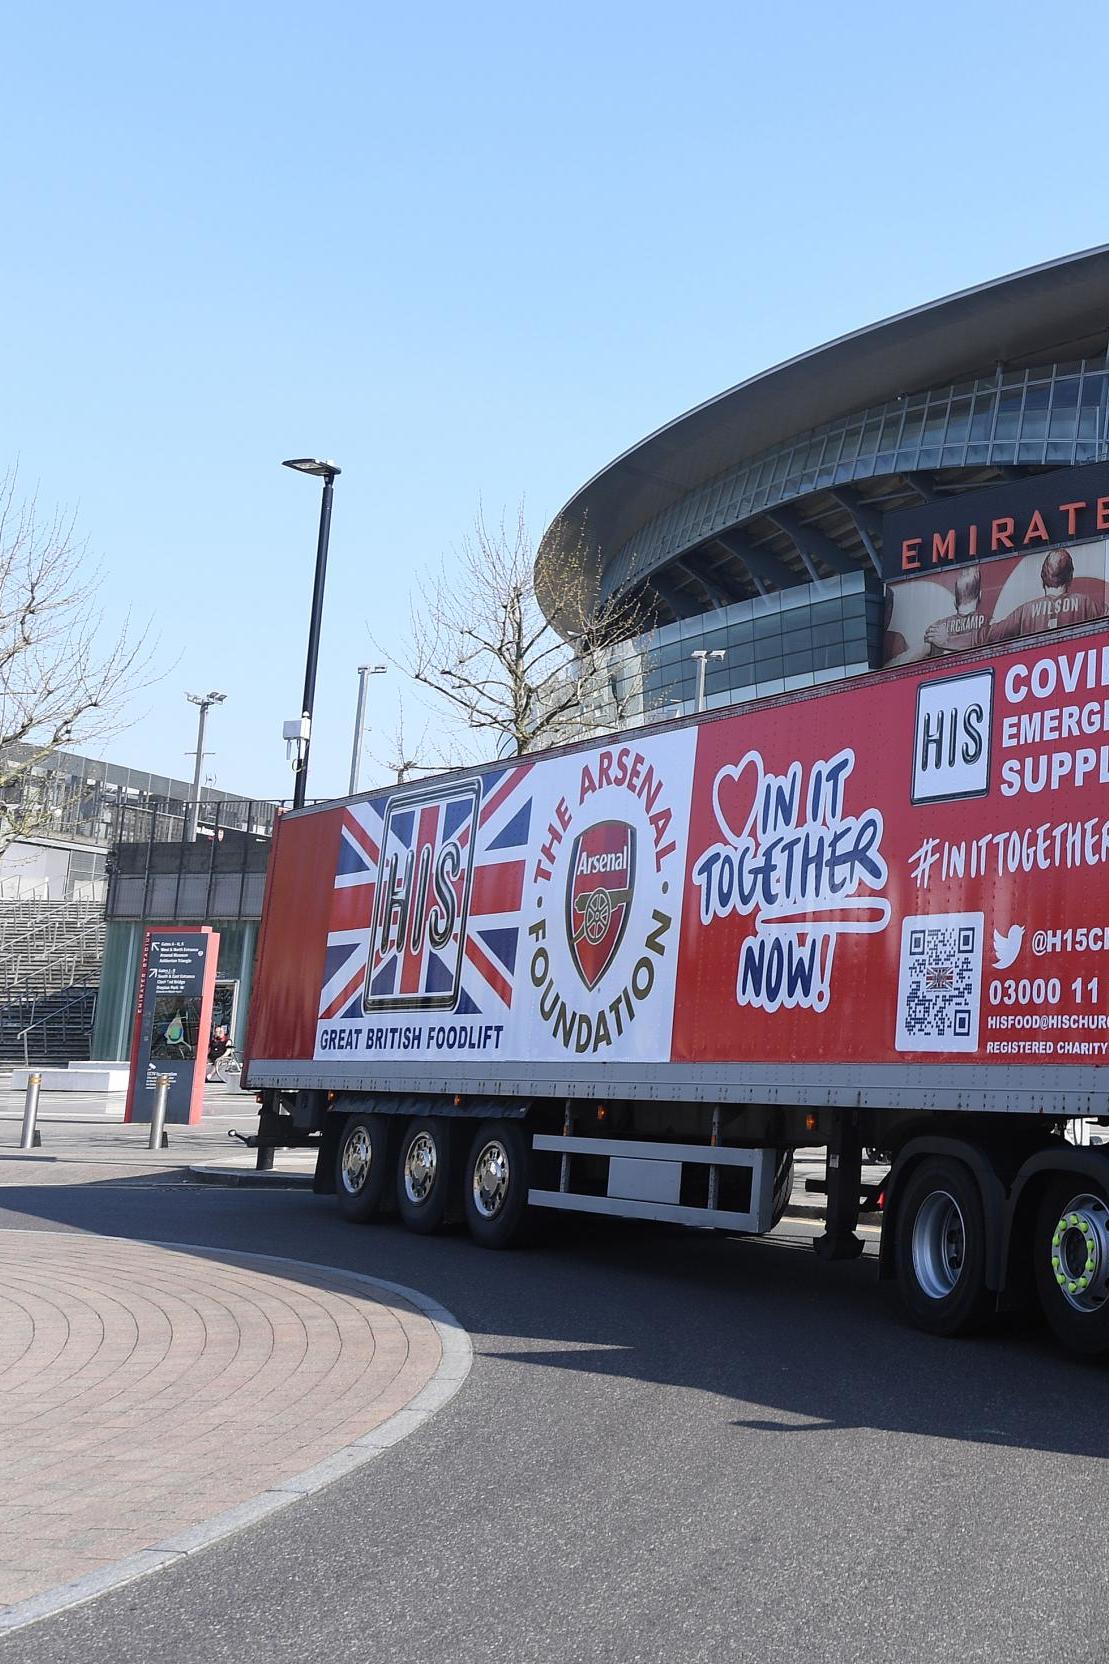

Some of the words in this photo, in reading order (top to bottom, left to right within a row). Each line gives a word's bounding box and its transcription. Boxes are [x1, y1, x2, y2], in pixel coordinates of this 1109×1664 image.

[1031, 597, 1080, 620] WILSON
[920, 703, 985, 772] HIS
[533, 796, 573, 884] THE
[579, 747, 677, 874] ARSENAL
[761, 769, 798, 836] IN
[810, 756, 851, 823] IT
[576, 844, 628, 877] Arsenal
[696, 816, 884, 918] TOGETHER
[377, 840, 462, 956] HIS
[528, 909, 673, 1055] FOUNDATION
[989, 977, 1061, 1005] 03000
[1071, 977, 1098, 1004] 11
[319, 1028, 363, 1051] GREAT
[365, 1026, 422, 1050] BRITISH
[426, 1024, 504, 1050] FOODLIFT
[986, 1041, 1054, 1054] REGISTERED
[1057, 1042, 1108, 1055] CHARITY
